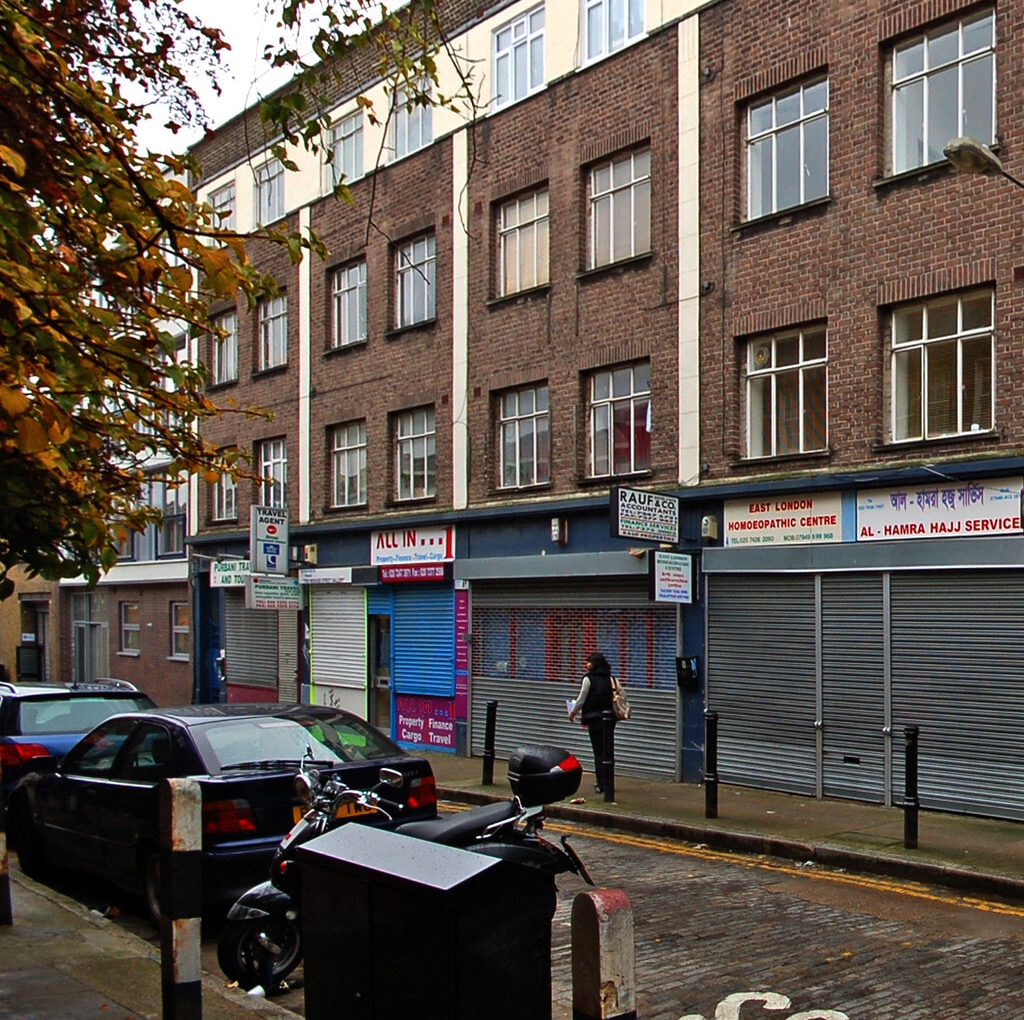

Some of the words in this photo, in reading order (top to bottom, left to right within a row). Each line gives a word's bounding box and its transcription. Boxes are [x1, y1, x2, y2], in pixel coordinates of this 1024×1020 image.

[620, 490, 654, 505] RAUF
[257, 509, 287, 518] TRAVEL
[620, 502, 677, 516] ACCOUNTANTS
[749, 502, 771, 514] EAST
[775, 499, 813, 512] LONDON
[259, 517, 285, 525] AGENT
[728, 518, 797, 531] HOMOEOPATHIC
[800, 515, 837, 527] CENTRE
[860, 526, 874, 538] AL
[884, 523, 925, 536] HAMRA
[930, 521, 961, 534] HAJJ
[965, 517, 1020, 532] SERVICE
[376, 531, 398, 550] ALL
[403, 529, 416, 548] IN
[221, 574, 232, 584] AND
[398, 714, 424, 730] Property
[428, 717, 454, 731] Finance
[401, 728, 422, 743] Cargo
[428, 731, 452, 745] Travel
